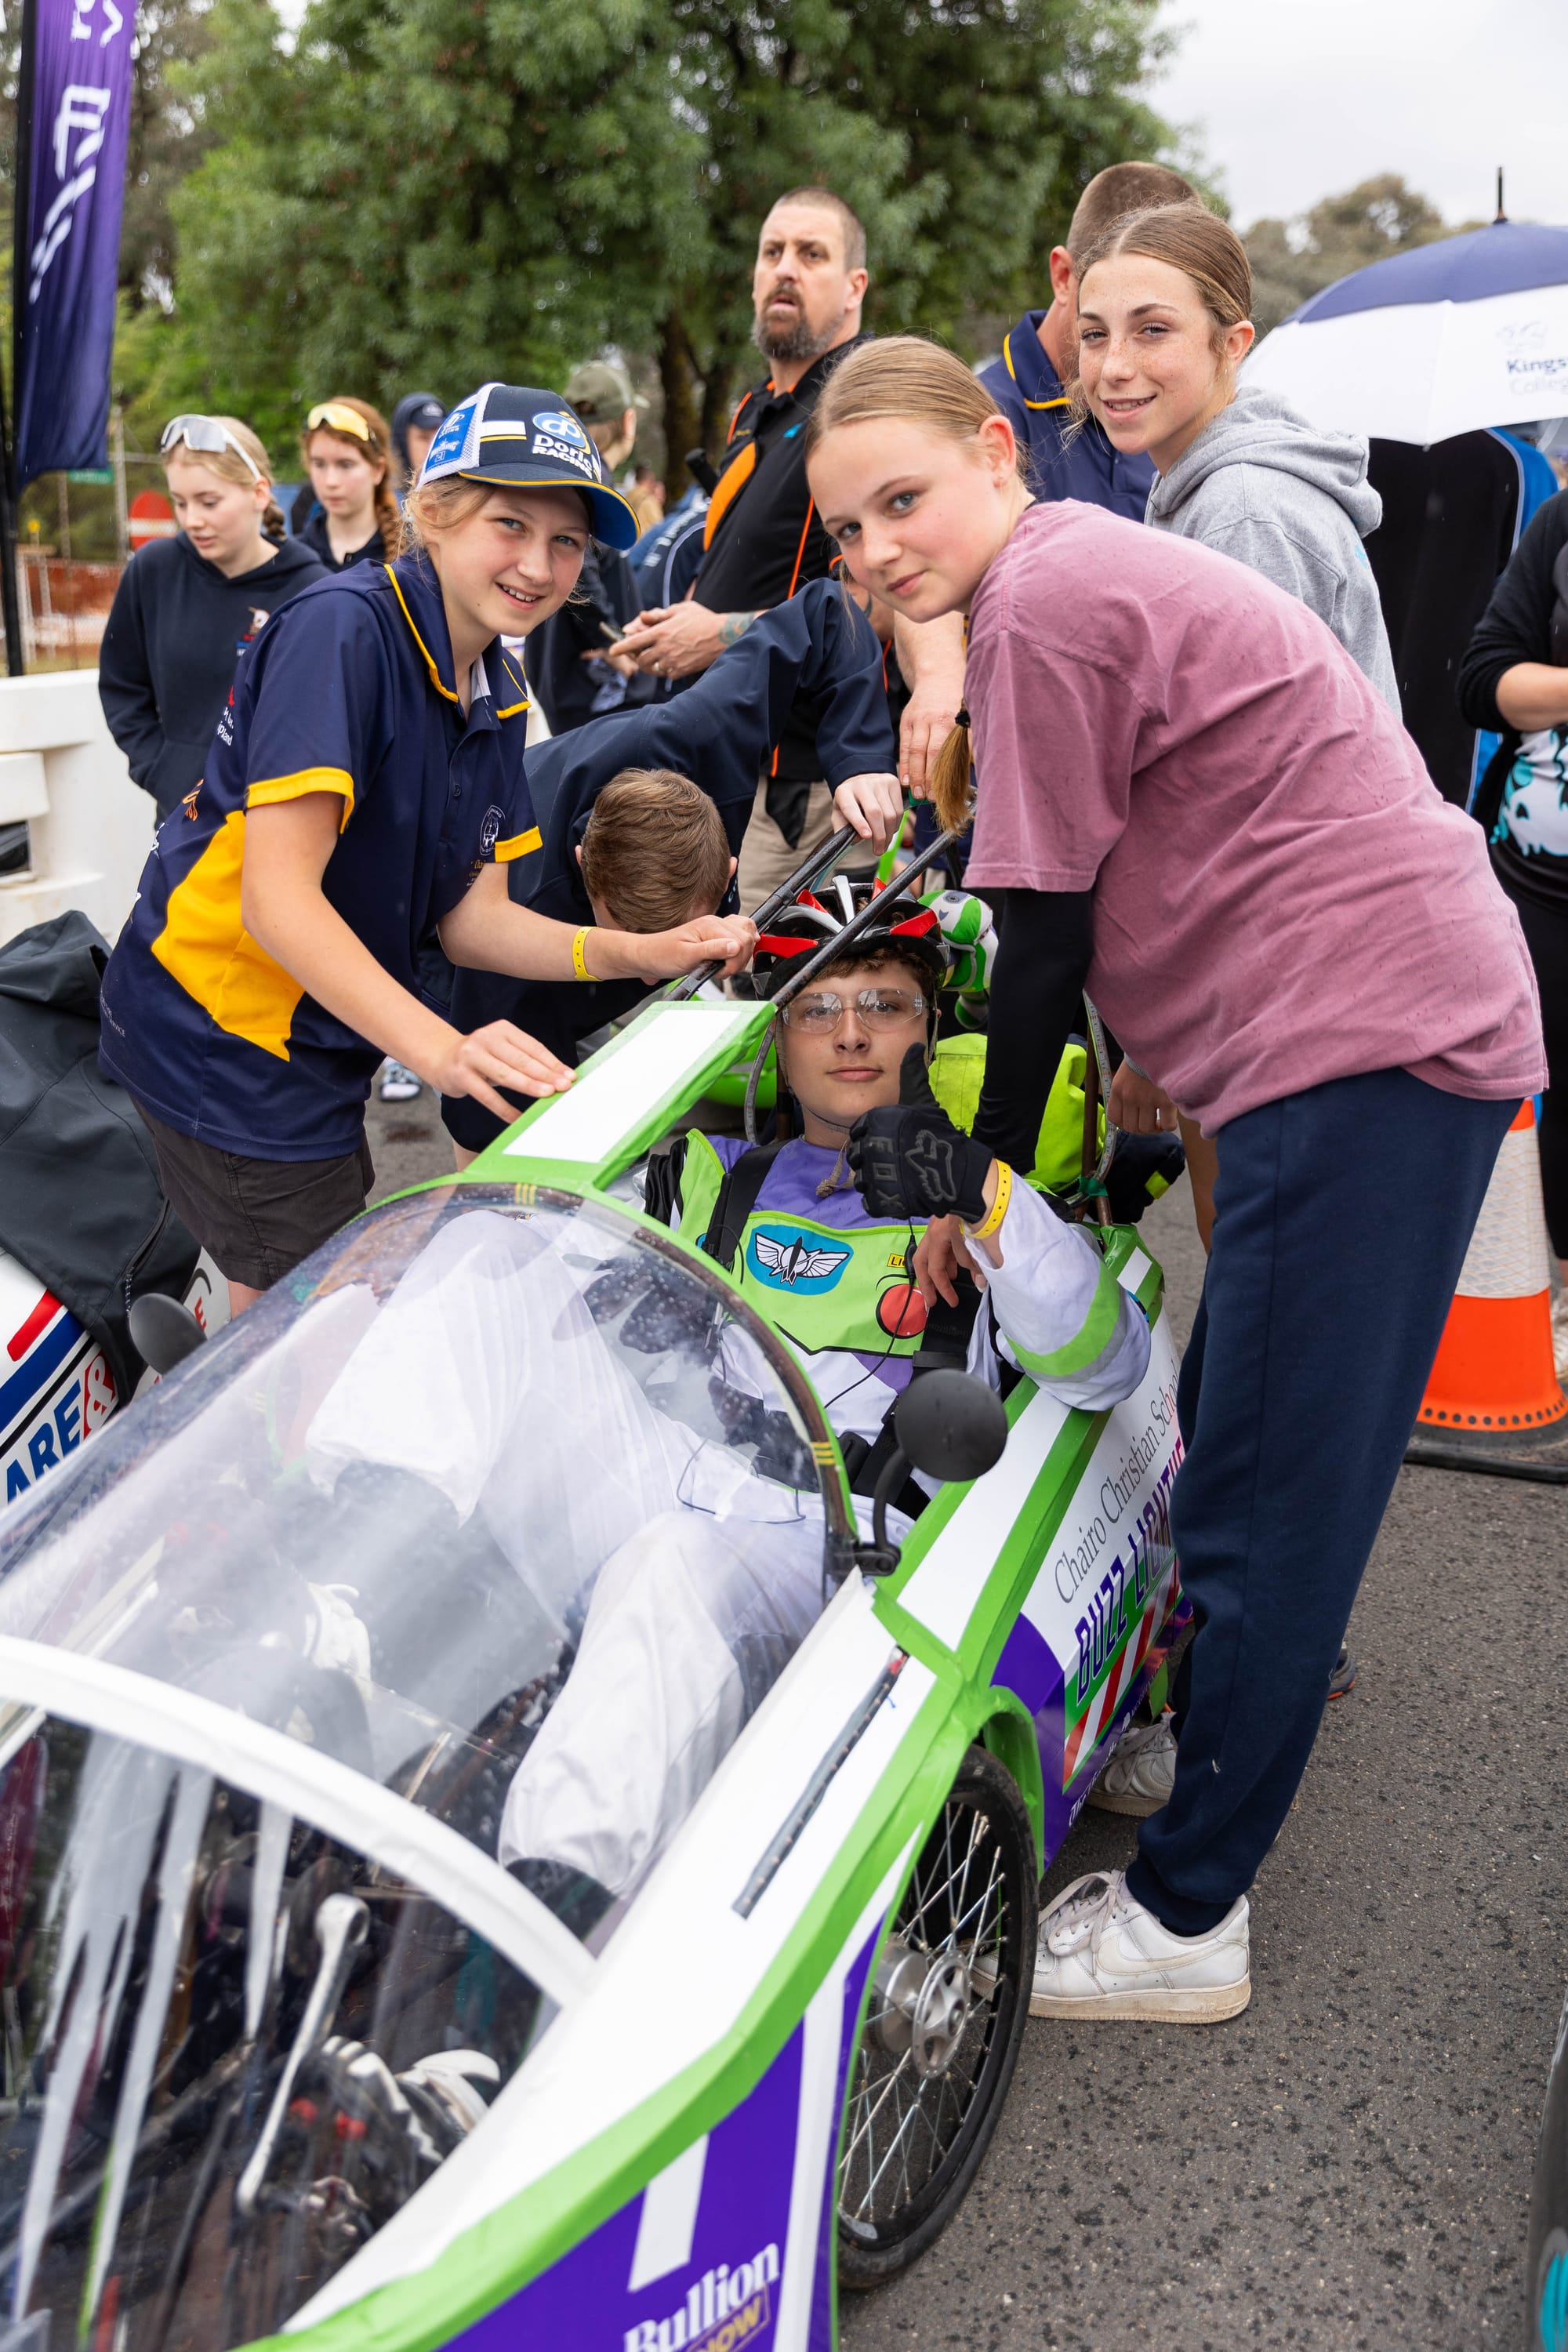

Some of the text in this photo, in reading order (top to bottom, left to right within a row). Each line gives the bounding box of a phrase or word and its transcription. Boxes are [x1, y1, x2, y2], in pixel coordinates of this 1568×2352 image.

[532, 445, 593, 480] RACING
[535, 434, 593, 471] Doric
[867, 1136, 906, 1210] FOX
[1054, 1516, 1106, 1603] Chairo
[1100, 1425, 1160, 1523] Christian
[1074, 1554, 1127, 1708] BUZZ
[623, 2242, 780, 2352] Bullion
